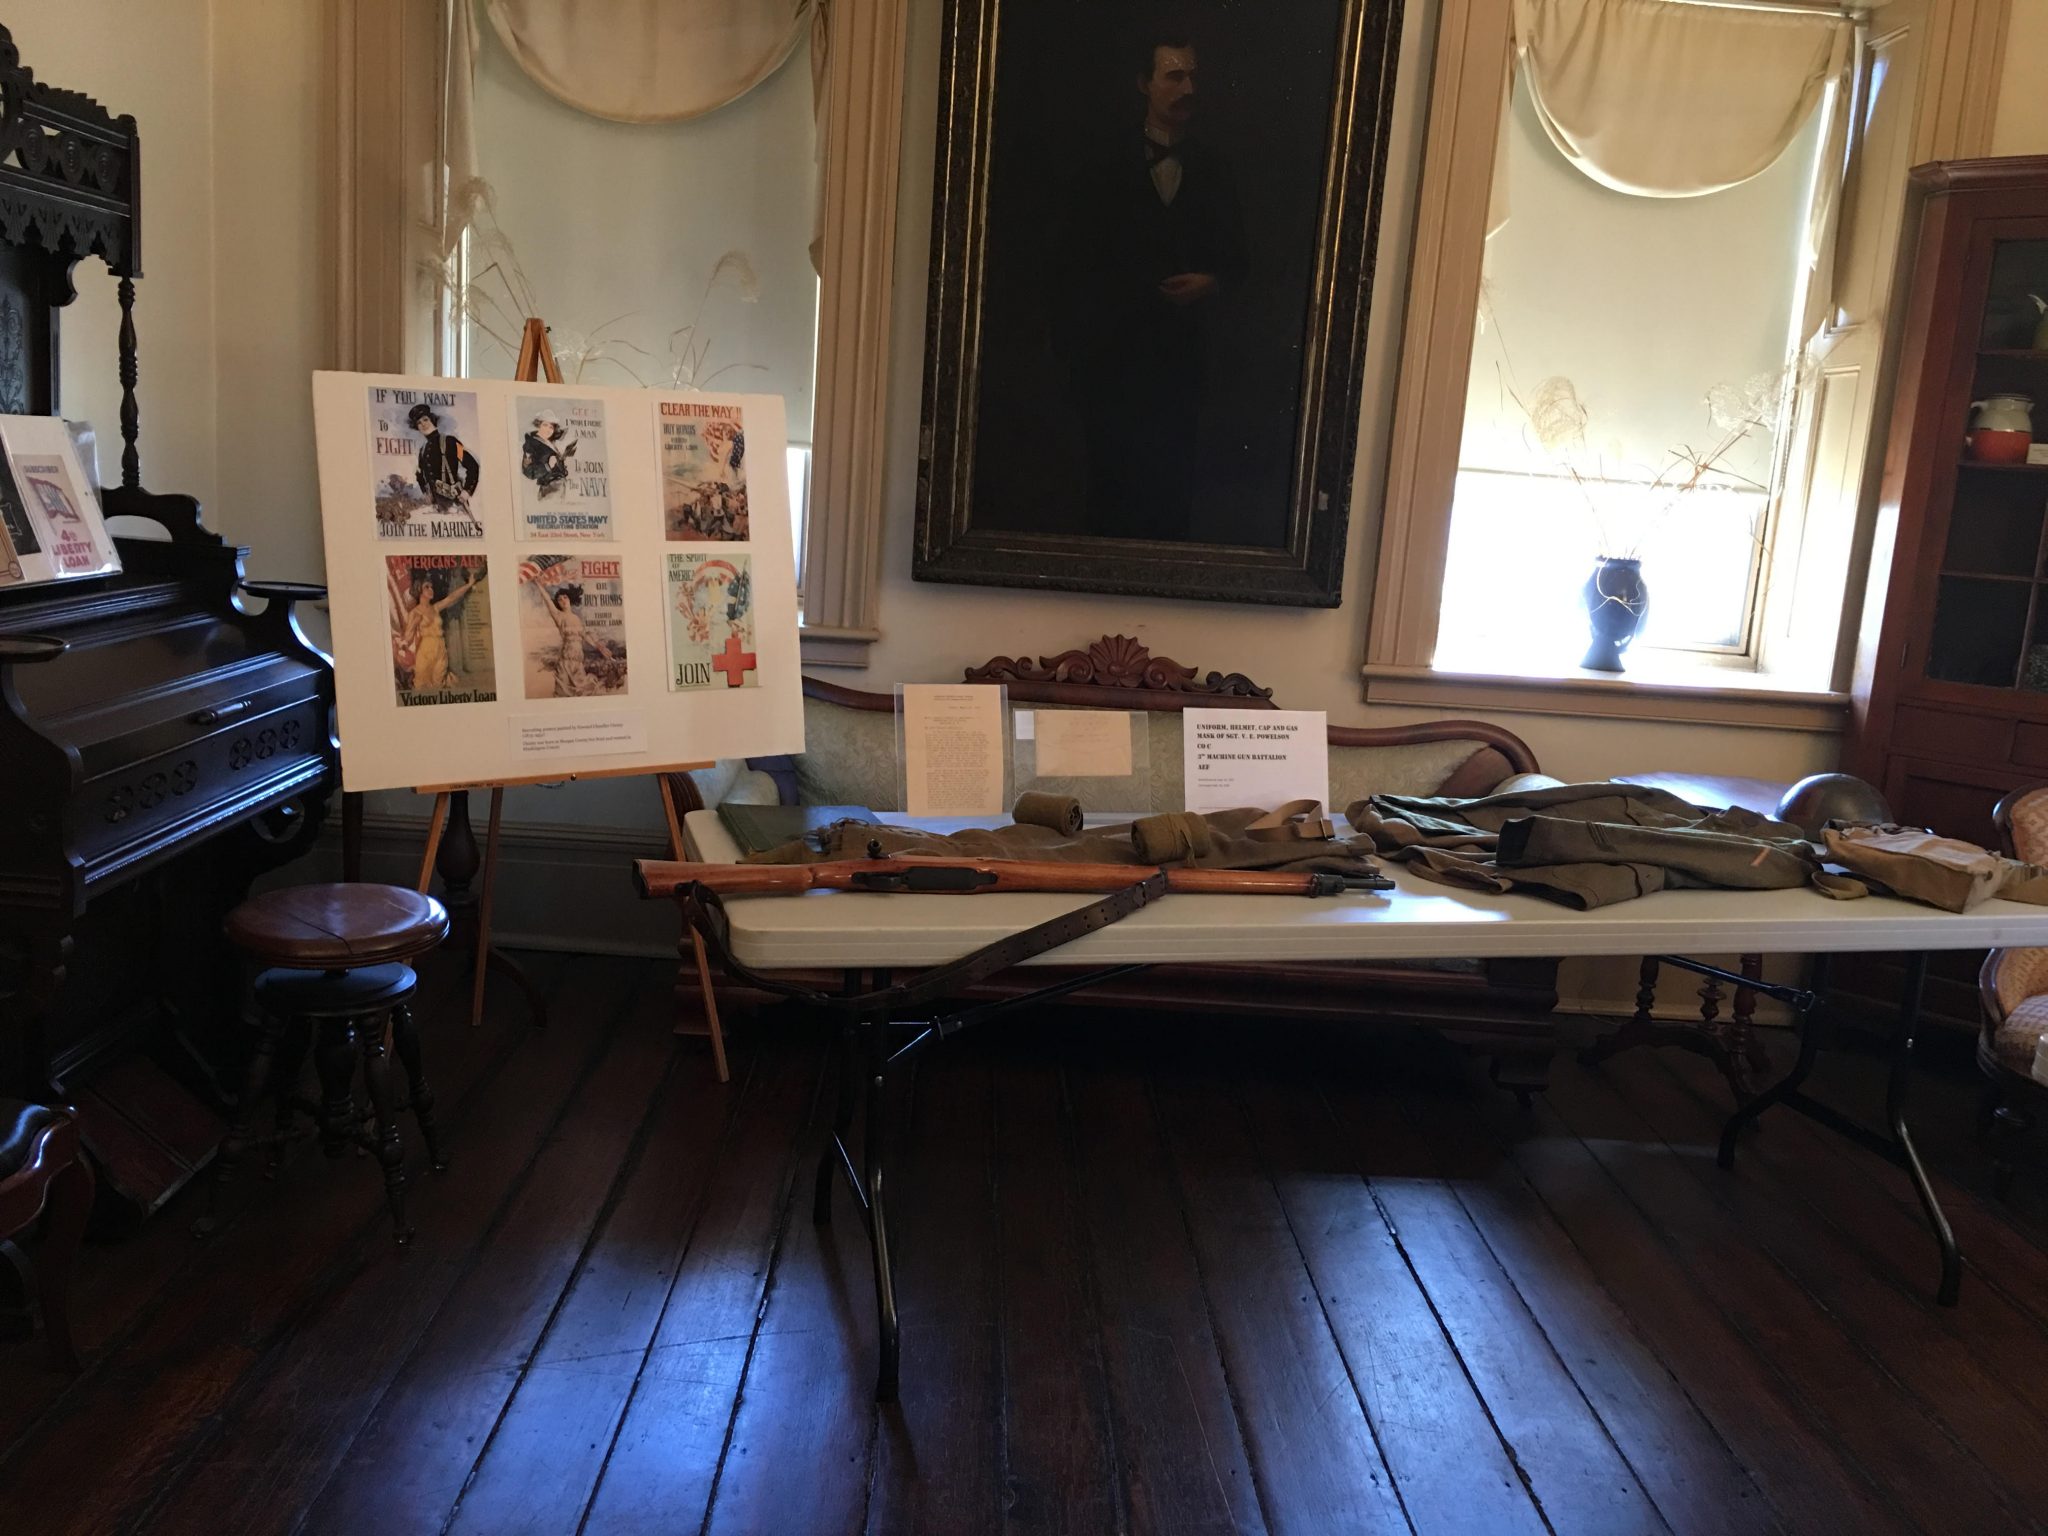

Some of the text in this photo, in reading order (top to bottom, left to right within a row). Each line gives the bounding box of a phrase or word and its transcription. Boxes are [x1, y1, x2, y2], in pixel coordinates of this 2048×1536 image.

[376, 389, 456, 406] IF YOU WANT
[660, 403, 690, 417] CLEAR
[690, 404, 710, 417] THE
[711, 405, 733, 419] WAY
[584, 461, 604, 475] JOIN
[579, 477, 608, 498] NAVY
[527, 515, 608, 525] UNITED STATES NAVY
[379, 520, 483, 538] JOIN THE MARINES
[52, 542, 92, 556] LIBERTY
[63, 555, 90, 568] LOAN
[669, 553, 707, 562] THE SPIRIT
[581, 561, 620, 576] FIGHT
[596, 582, 607, 590] OR
[584, 594, 623, 607] BUY BONDS
[676, 662, 711, 685] JOIN
[400, 689, 497, 706] Victory Liberty Loan
